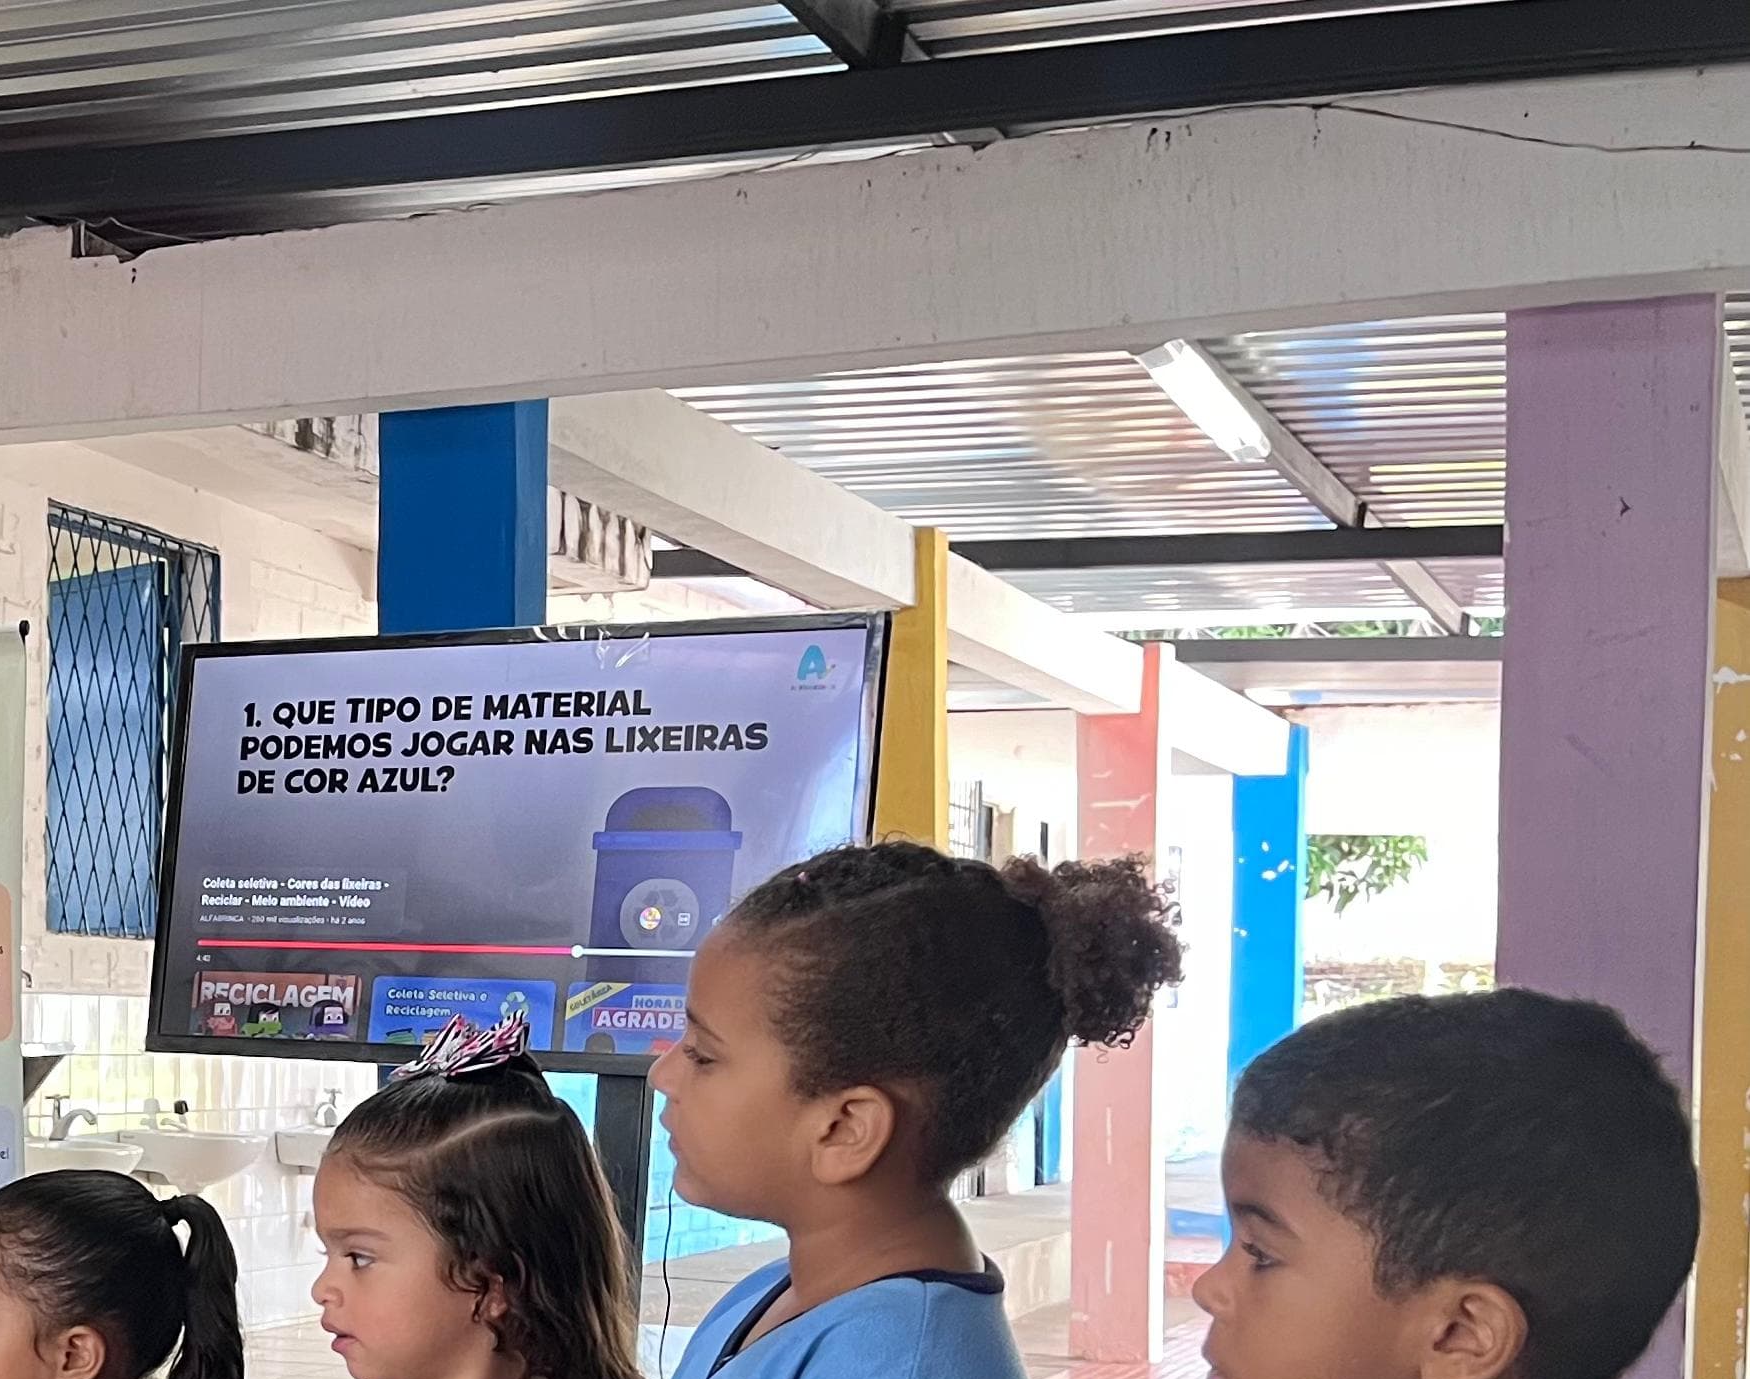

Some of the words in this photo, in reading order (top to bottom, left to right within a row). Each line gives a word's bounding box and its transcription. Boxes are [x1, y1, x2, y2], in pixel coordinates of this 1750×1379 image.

[244, 703, 261, 727] 1.
[273, 701, 335, 729] QUE
[347, 697, 421, 723] TIPO
[432, 695, 473, 721] DE
[483, 689, 651, 720] MATERIAL
[240, 732, 392, 760] PODEMOS
[401, 730, 514, 757] JOGAR
[524, 728, 593, 756] NAS
[606, 722, 768, 754] LIXEIRAS
[238, 770, 275, 794] DE
[285, 768, 348, 793] COR
[357, 765, 455, 792] AZUL?
[203, 878, 235, 889] Coleta
[238, 878, 278, 890] seletiva
[287, 878, 318, 890] Cores
[321, 878, 339, 890] das
[202, 895, 242, 906] Reciclar
[252, 895, 278, 906] Meio
[280, 895, 329, 907] ambiente
[340, 895, 370, 908] Vídeo
[200, 981, 353, 1008] RECICLAGEM
[388, 988, 424, 1000] Coleta
[428, 989, 475, 1001] Seletiva
[481, 993, 488, 1001] e
[386, 1004, 451, 1017] Reciclagem
[634, 999, 666, 1009] HORA
